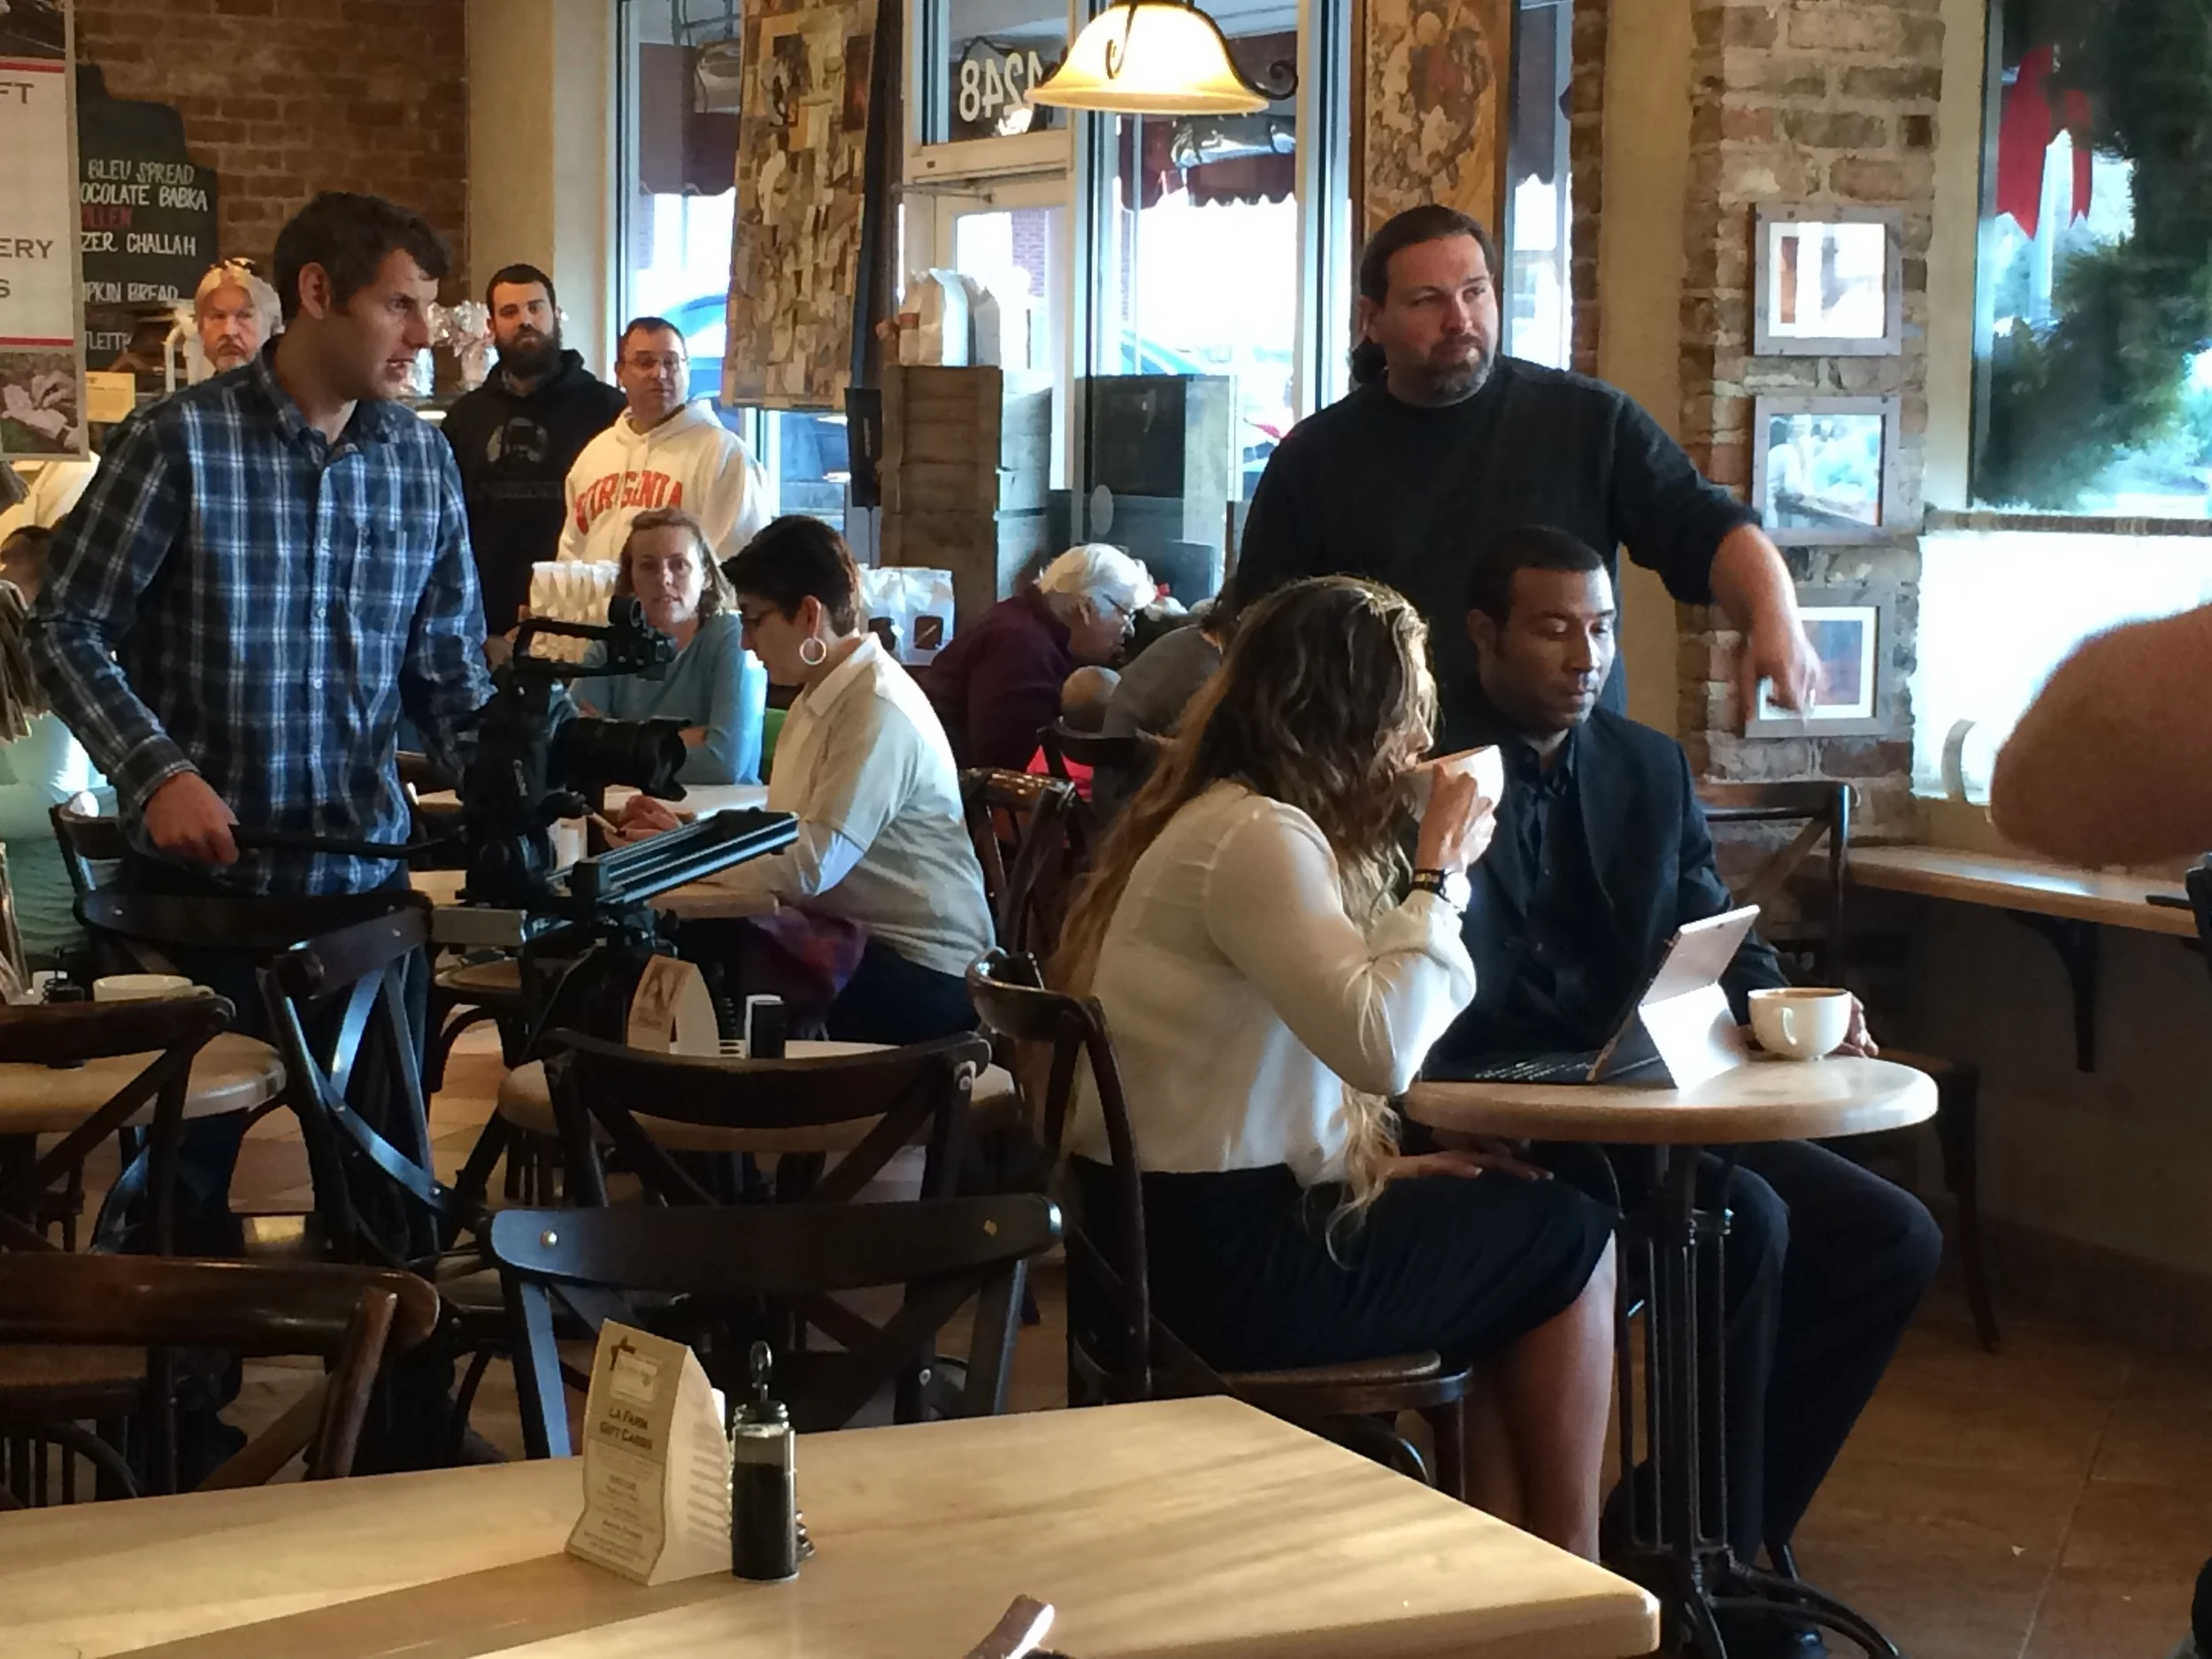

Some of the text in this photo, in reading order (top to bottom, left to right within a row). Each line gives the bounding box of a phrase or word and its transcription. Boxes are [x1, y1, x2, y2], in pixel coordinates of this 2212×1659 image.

[88, 158, 195, 185] BLEU SPREAD
[158, 186, 208, 212] BABKA
[127, 233, 196, 257] CHALLAH
[127, 282, 179, 303] BREAD
[575, 470, 682, 535] VIRGINIA
